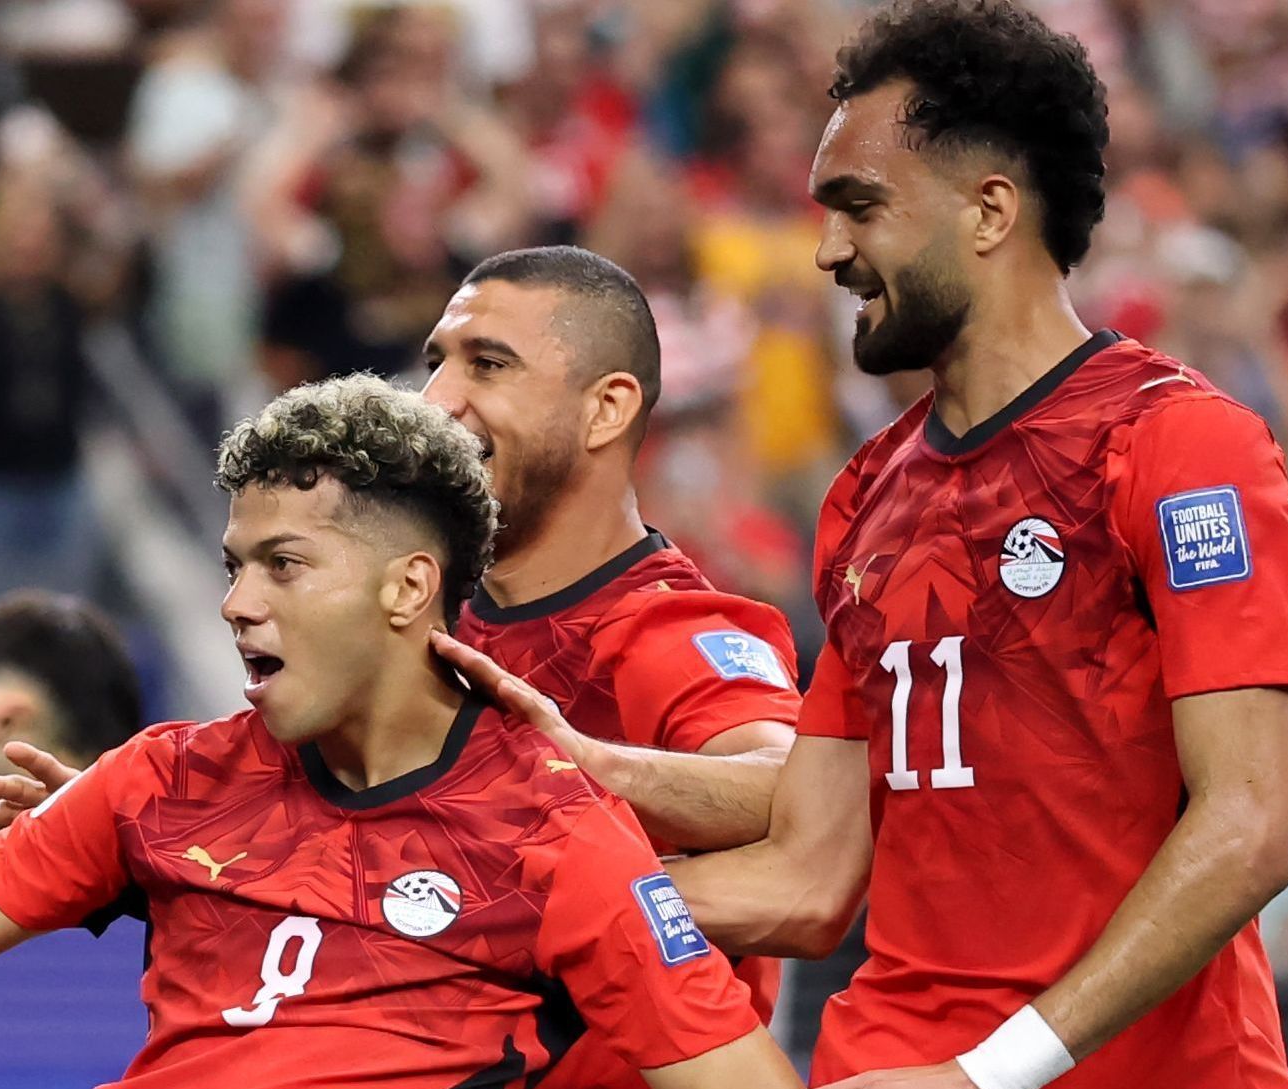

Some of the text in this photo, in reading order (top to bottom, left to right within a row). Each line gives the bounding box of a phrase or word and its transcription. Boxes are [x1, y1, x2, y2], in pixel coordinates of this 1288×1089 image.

[1171, 502, 1228, 525] FOOTBALL
[1174, 517, 1231, 544] UNITES
[1175, 536, 1236, 563] the World
[1195, 559, 1220, 572] FIFA
[879, 636, 975, 791] 11
